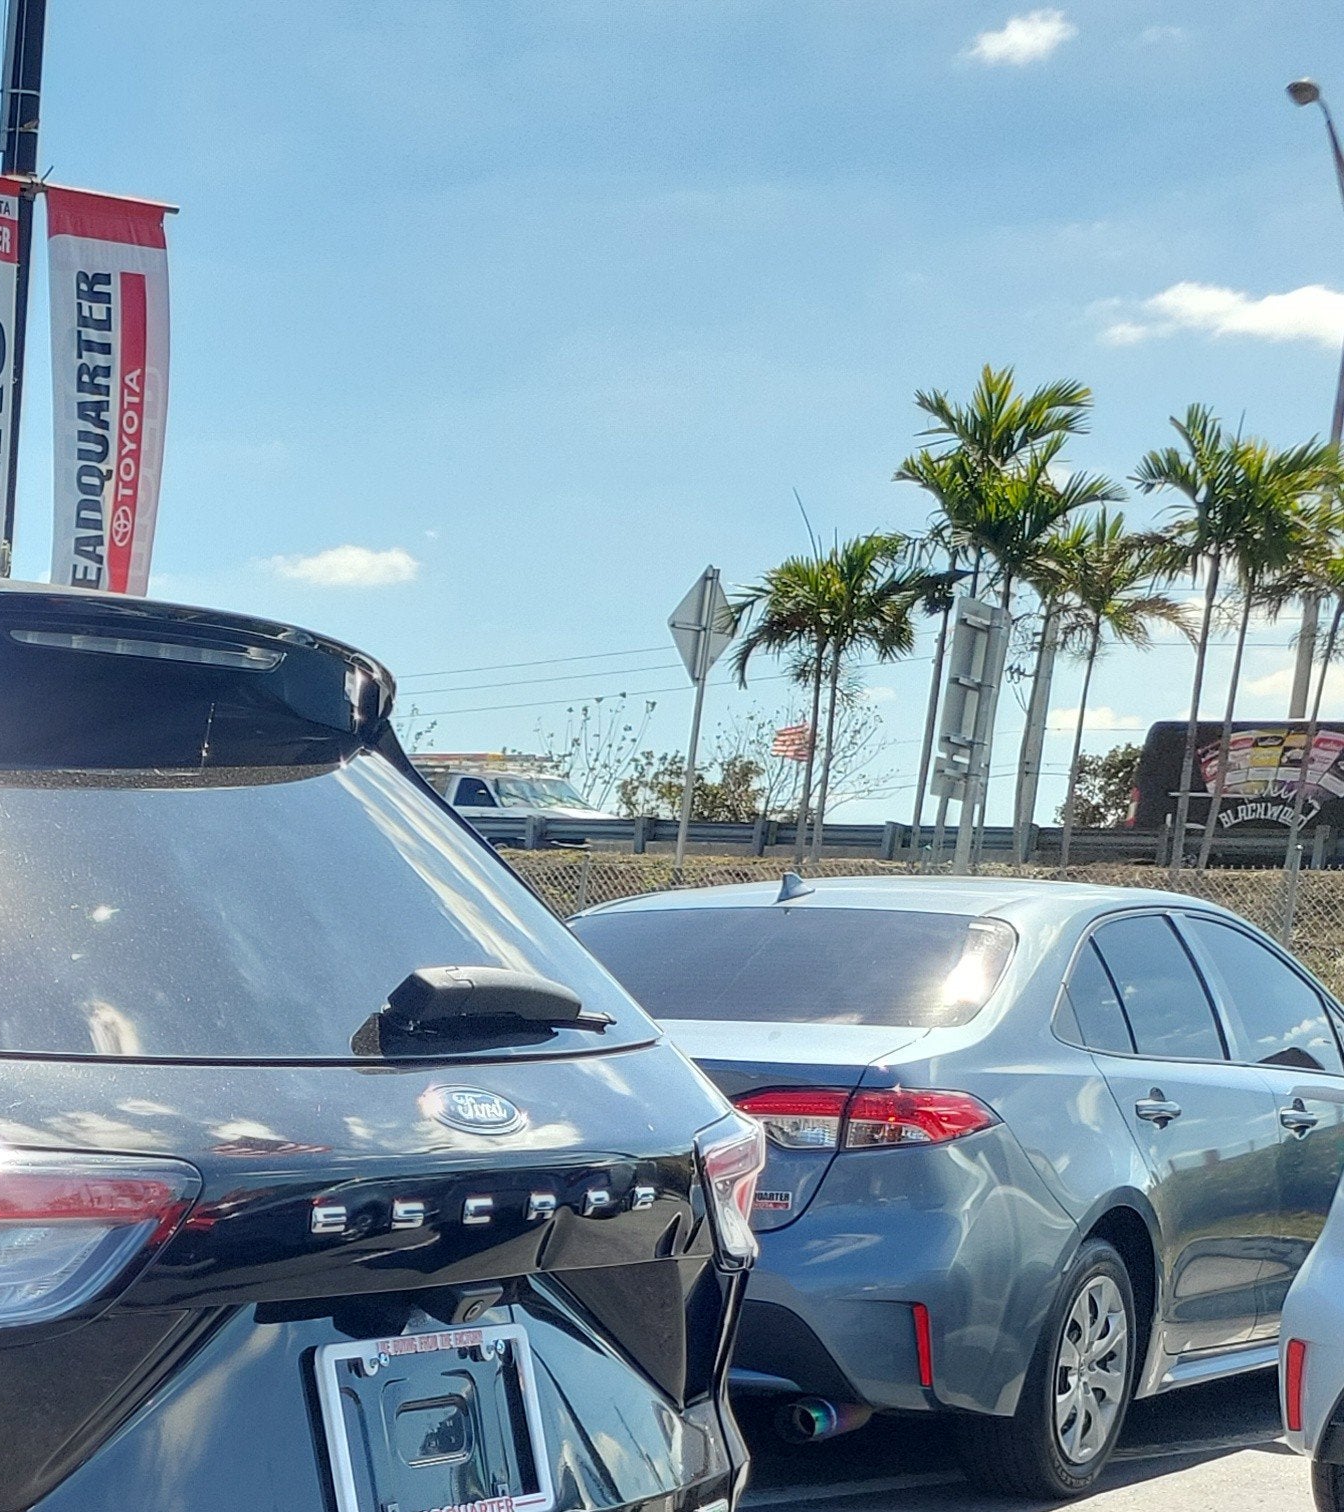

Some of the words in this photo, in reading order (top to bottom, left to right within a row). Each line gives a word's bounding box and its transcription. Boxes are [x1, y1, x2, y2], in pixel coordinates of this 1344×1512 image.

[71, 269, 113, 589] EADQUARTER
[117, 368, 142, 502] TOYOTA
[451, 1093, 508, 1120] Ford
[310, 1186, 656, 1234] ESCAPE
